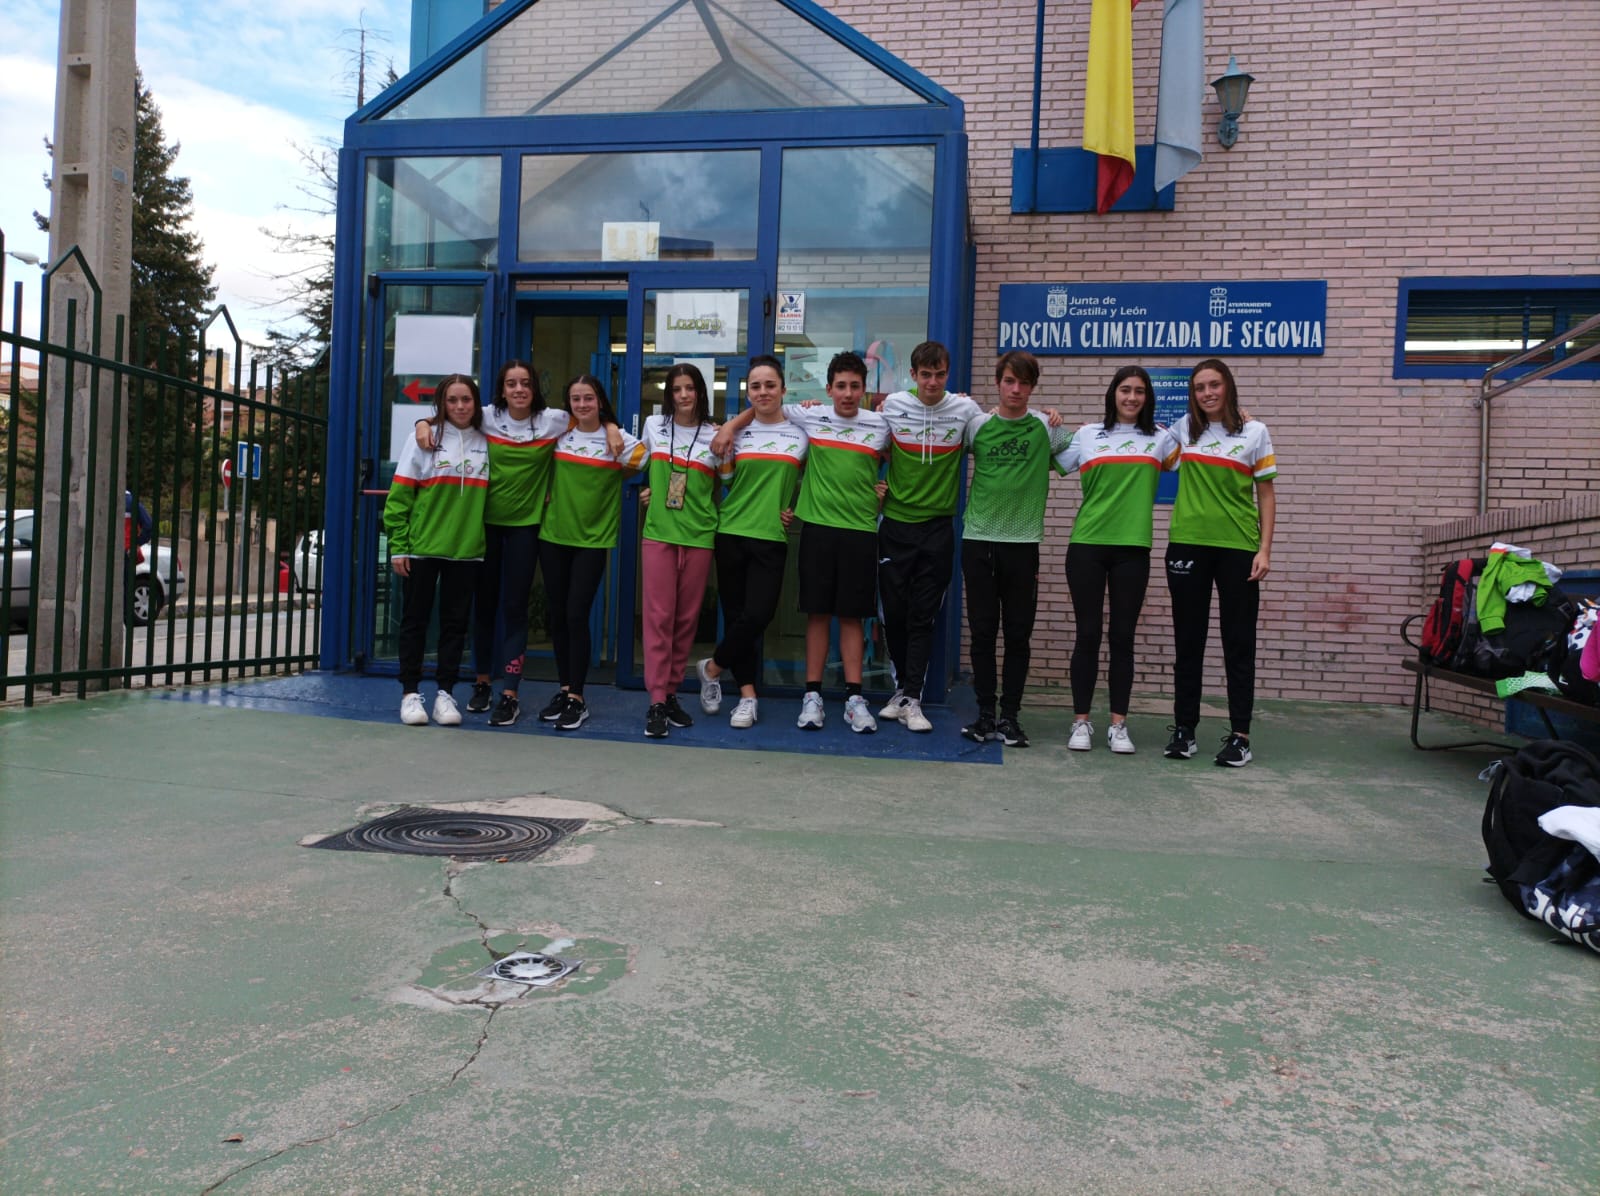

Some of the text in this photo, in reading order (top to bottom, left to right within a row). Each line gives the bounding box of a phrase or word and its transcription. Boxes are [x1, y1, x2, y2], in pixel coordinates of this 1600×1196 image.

[1068, 296, 1117, 305] Junta de
[1068, 306, 1147, 318] Castilla y León
[1000, 321, 1322, 347] PISCINA CLIMATIZADA DE SEGOVIA
